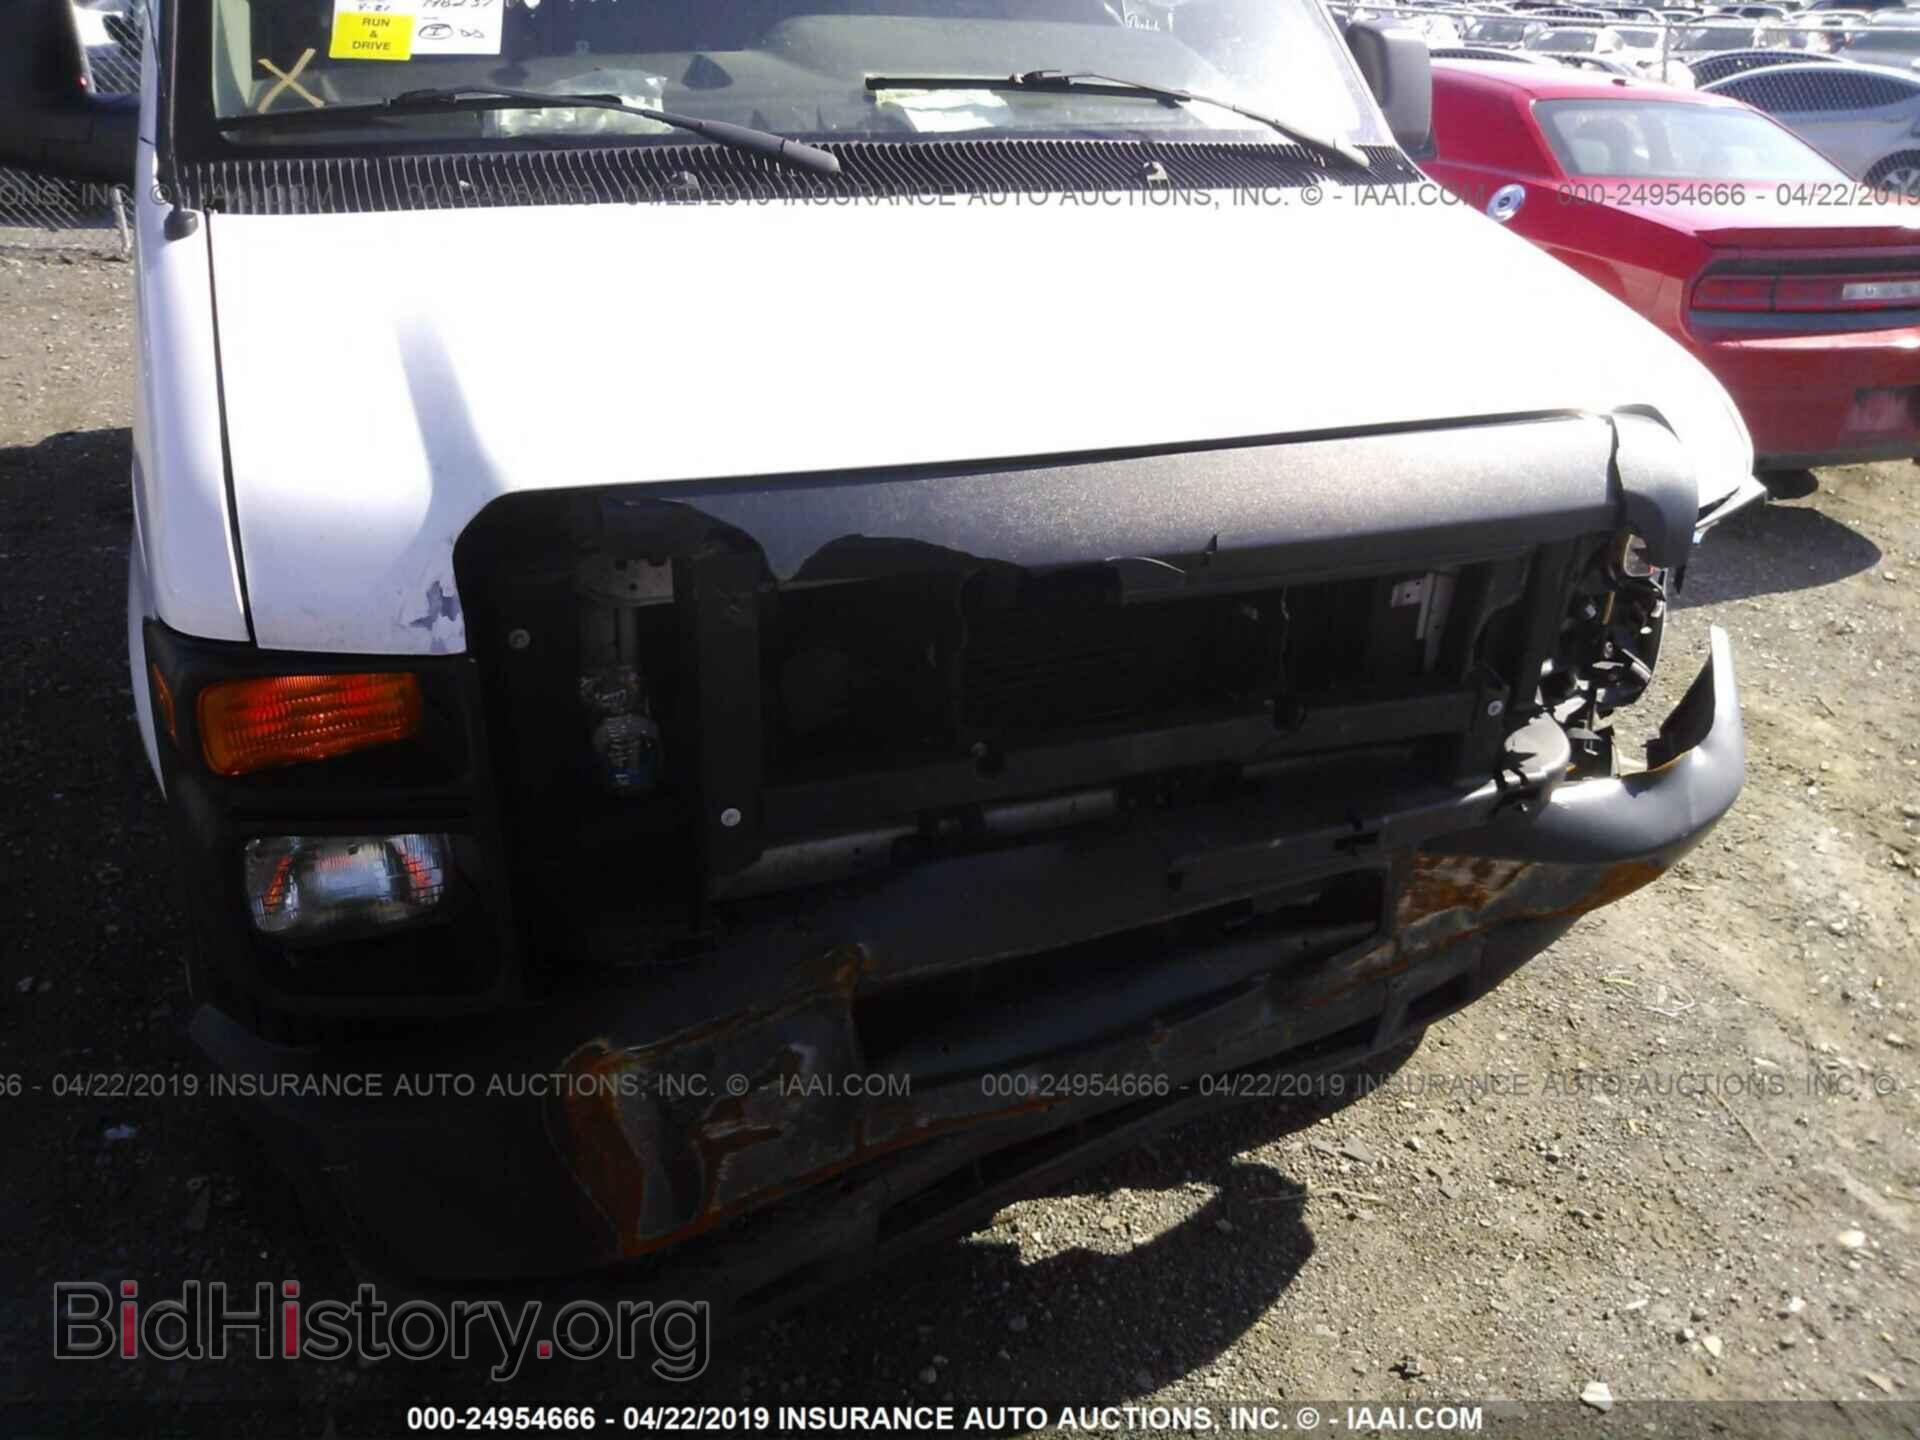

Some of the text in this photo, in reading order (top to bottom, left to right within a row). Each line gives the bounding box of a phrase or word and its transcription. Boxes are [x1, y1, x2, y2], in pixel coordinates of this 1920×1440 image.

[362, 18, 390, 27] RUN
[369, 31, 379, 39] &
[352, 41, 391, 51] DRIVE
